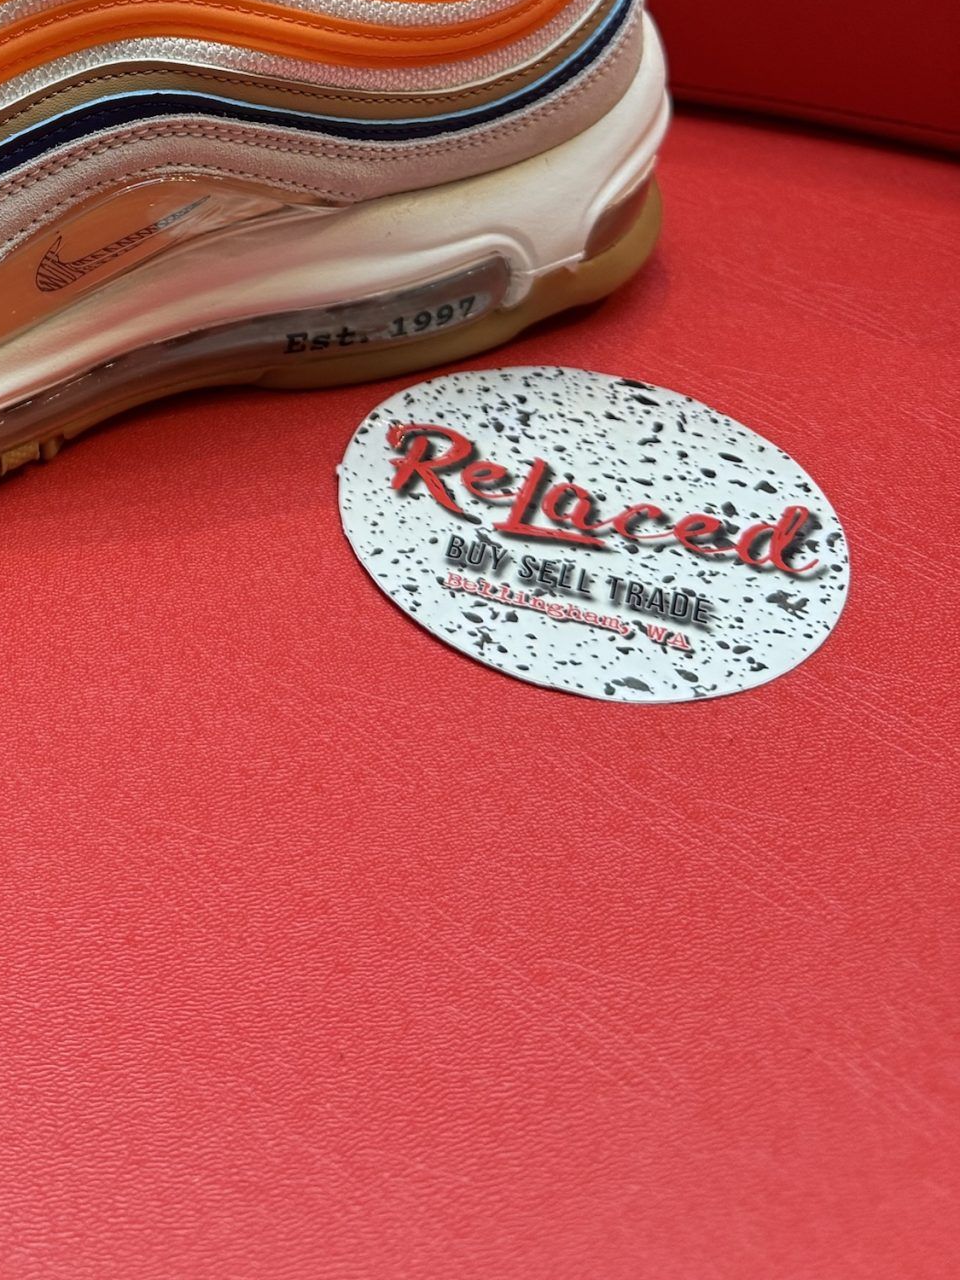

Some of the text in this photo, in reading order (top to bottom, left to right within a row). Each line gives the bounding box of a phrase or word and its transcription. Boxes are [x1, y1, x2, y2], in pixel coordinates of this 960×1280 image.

[283, 295, 476, 354] Est. 1997
[443, 572, 693, 651] Bellingham, WA
[445, 534, 712, 623] BUY SELL TRADE
